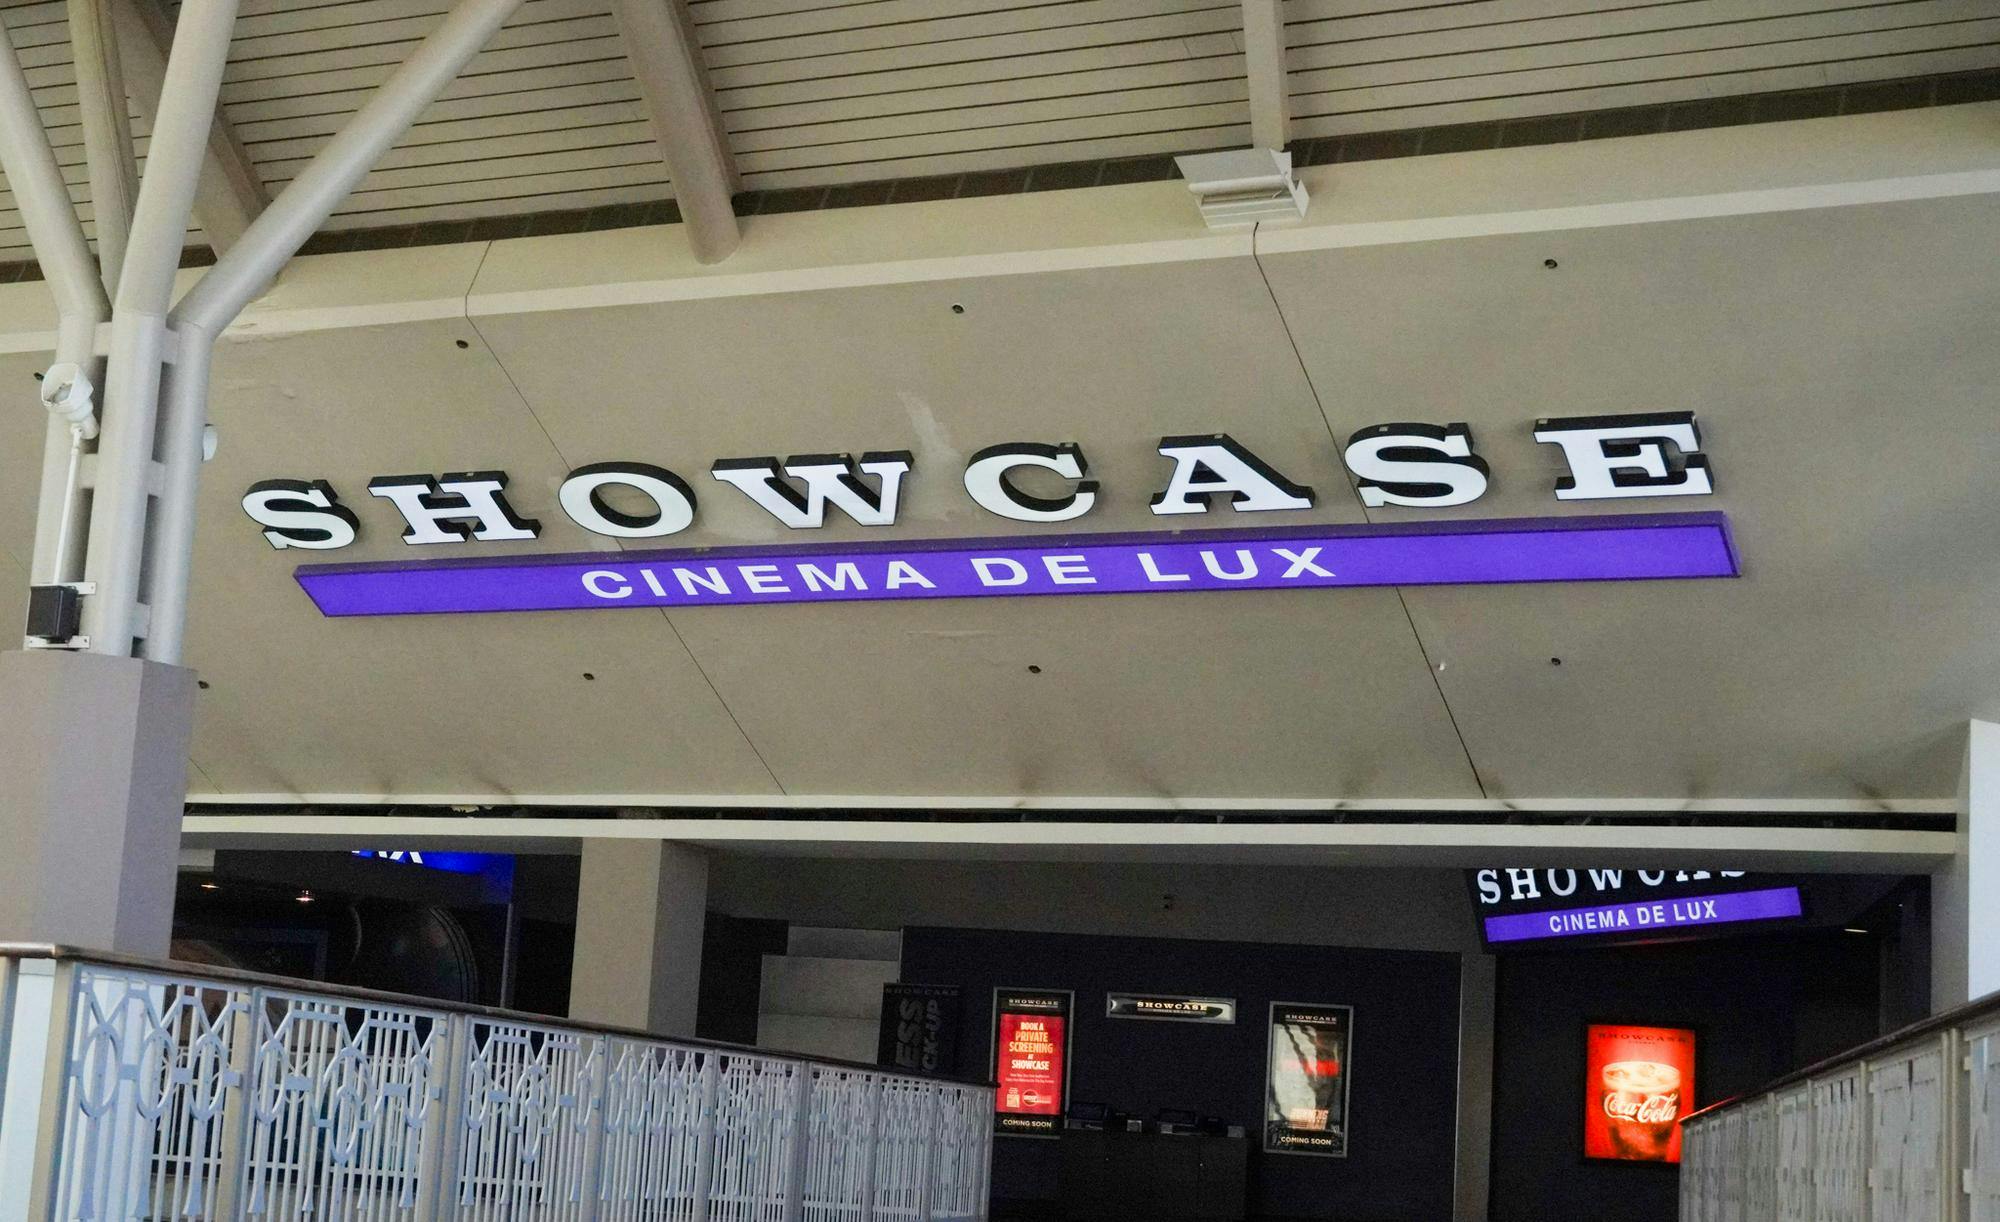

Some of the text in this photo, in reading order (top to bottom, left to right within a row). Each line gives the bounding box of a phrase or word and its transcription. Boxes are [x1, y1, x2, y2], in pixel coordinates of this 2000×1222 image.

[242, 411, 1715, 550] SHOWCASE
[581, 547, 1336, 599] CINEMA DE LUX
[1477, 868, 1746, 904] SHOW
[1550, 900, 1717, 932] CINEMA DE LUX
[1008, 998, 1058, 1006] SHOWCASE
[1137, 1001, 1207, 1011] SHOWCASE
[1285, 1014, 1336, 1022] SHOWCASE
[1020, 1022, 1044, 1031] BOOK A
[1015, 1031, 1048, 1042] PRIVATE
[1009, 1041, 1053, 1054] SCREENING
[1011, 1060, 1050, 1070] SHOWCASE
[1604, 1092, 1678, 1123] Coca-Cola
[1003, 1119, 1052, 1128] COMING SOON
[1281, 1136, 1309, 1144] COMING
